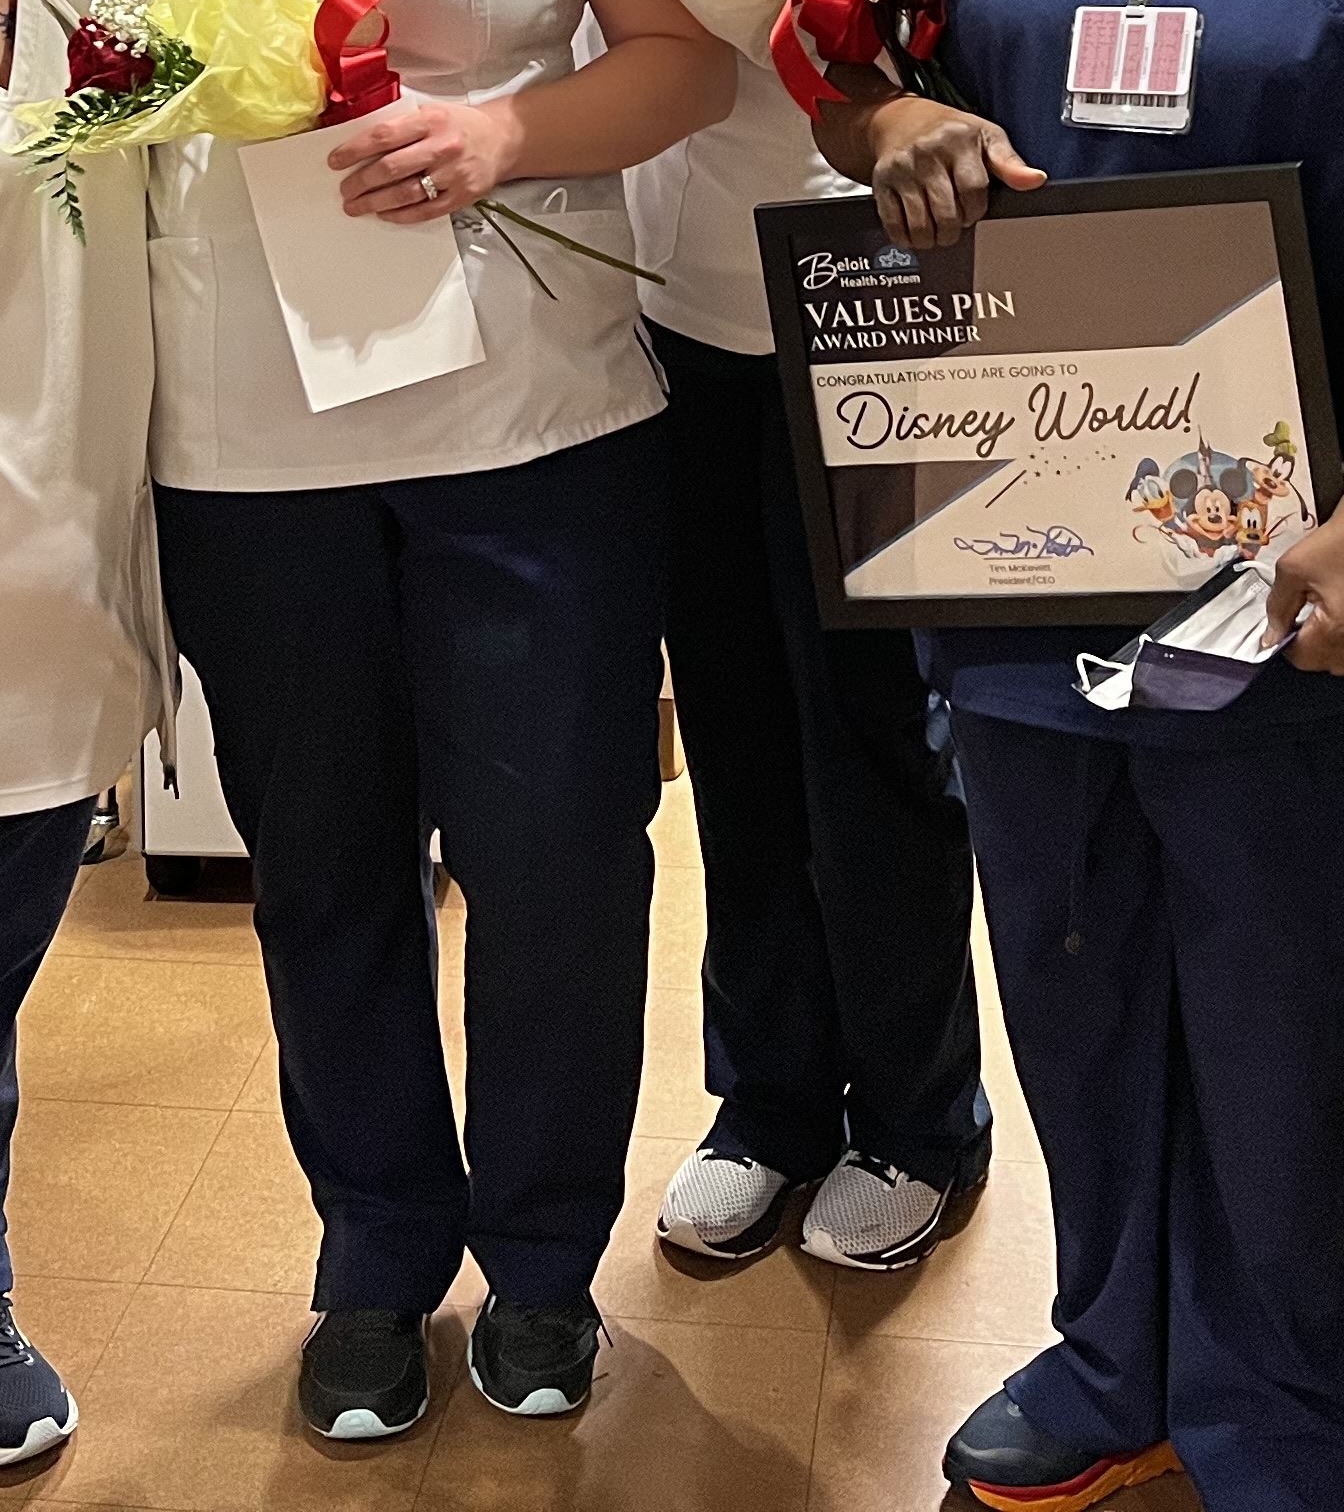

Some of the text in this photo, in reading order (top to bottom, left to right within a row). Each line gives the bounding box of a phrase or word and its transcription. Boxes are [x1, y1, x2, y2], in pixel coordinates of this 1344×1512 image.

[797, 252, 871, 290] Beloit
[840, 273, 922, 289] Health System
[804, 290, 1016, 329] VALUES PIN
[811, 324, 982, 352] AWARD WINNER
[816, 363, 1079, 388] CONGRATULATIONS YOU ARE GOING TO
[836, 372, 1201, 459] Disney World!
